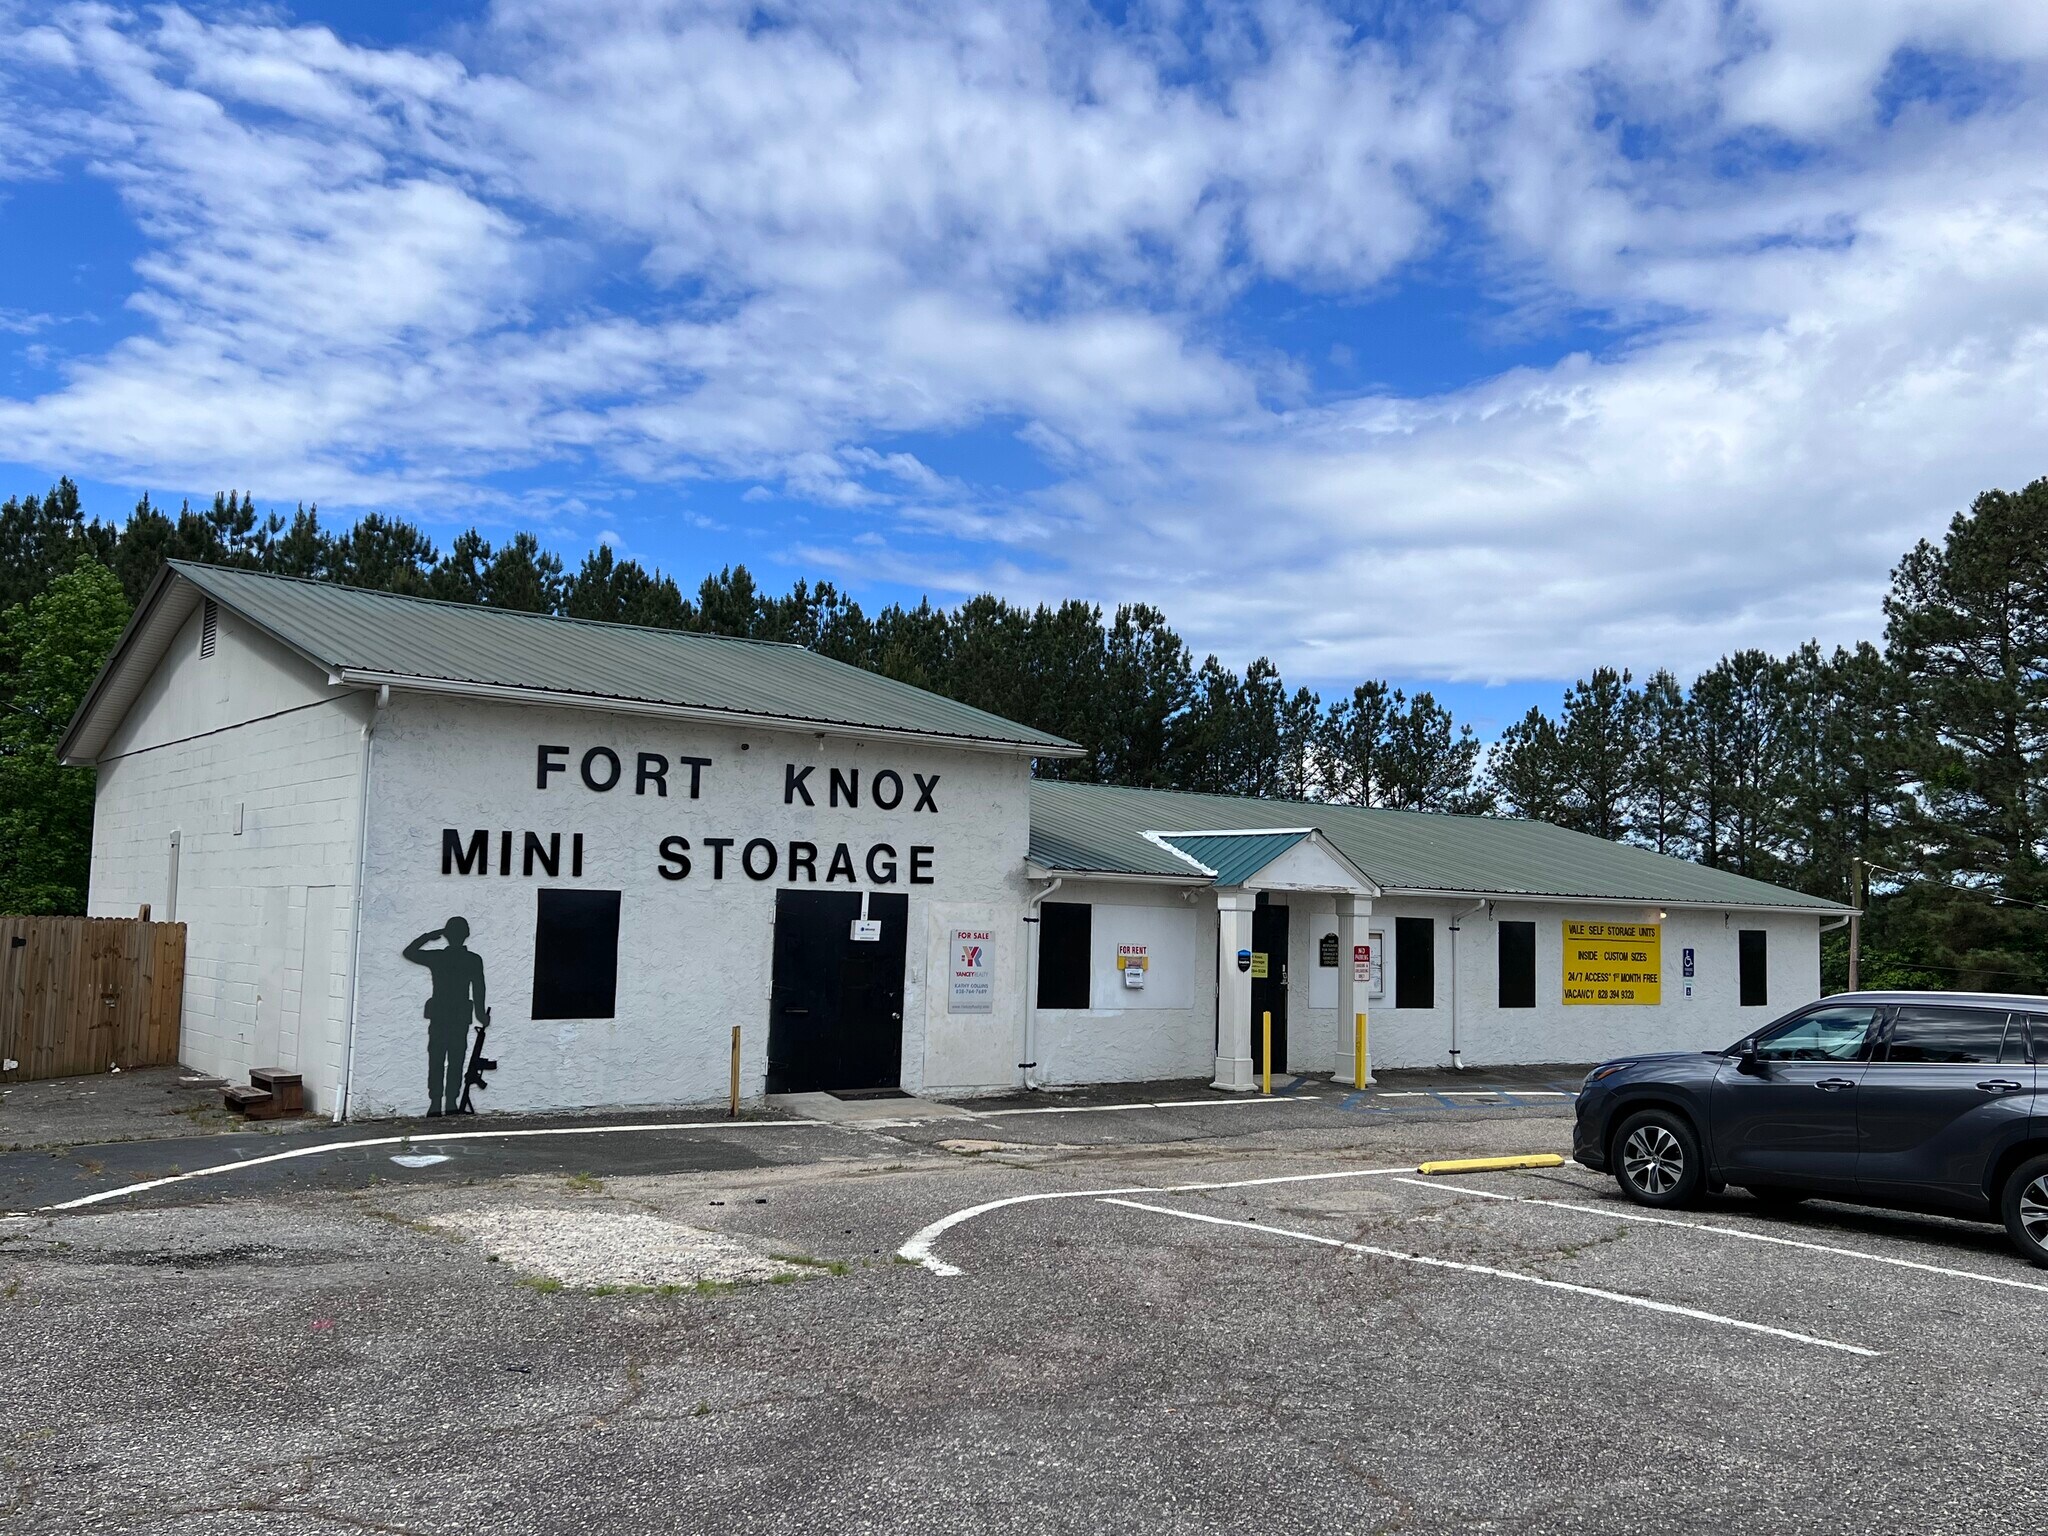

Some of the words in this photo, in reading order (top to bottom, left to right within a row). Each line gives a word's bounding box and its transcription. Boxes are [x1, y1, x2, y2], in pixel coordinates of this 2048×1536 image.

[537, 744, 712, 799] FORT
[784, 763, 941, 813] KNOX
[442, 828, 583, 877] MINI
[657, 835, 935, 884] STORAGE
[1568, 925, 1584, 935] VALE
[1589, 926, 1604, 935] SELF
[1608, 926, 1635, 936] STORAGE
[1639, 928, 1655, 937] UNITS
[1120, 946, 1130, 954] FOR
[1578, 951, 1598, 960] INSIDE
[1604, 952, 1628, 961] CUSTOM
[1631, 952, 1647, 962] SIZES
[1568, 972, 1582, 982] 24/7
[1621, 974, 1641, 982] MONTH
[1643, 974, 1658, 983] FREE
[1564, 989, 1594, 998] VACANCY
[1598, 990, 1608, 999] 828
[1610, 990, 1620, 999] 394
